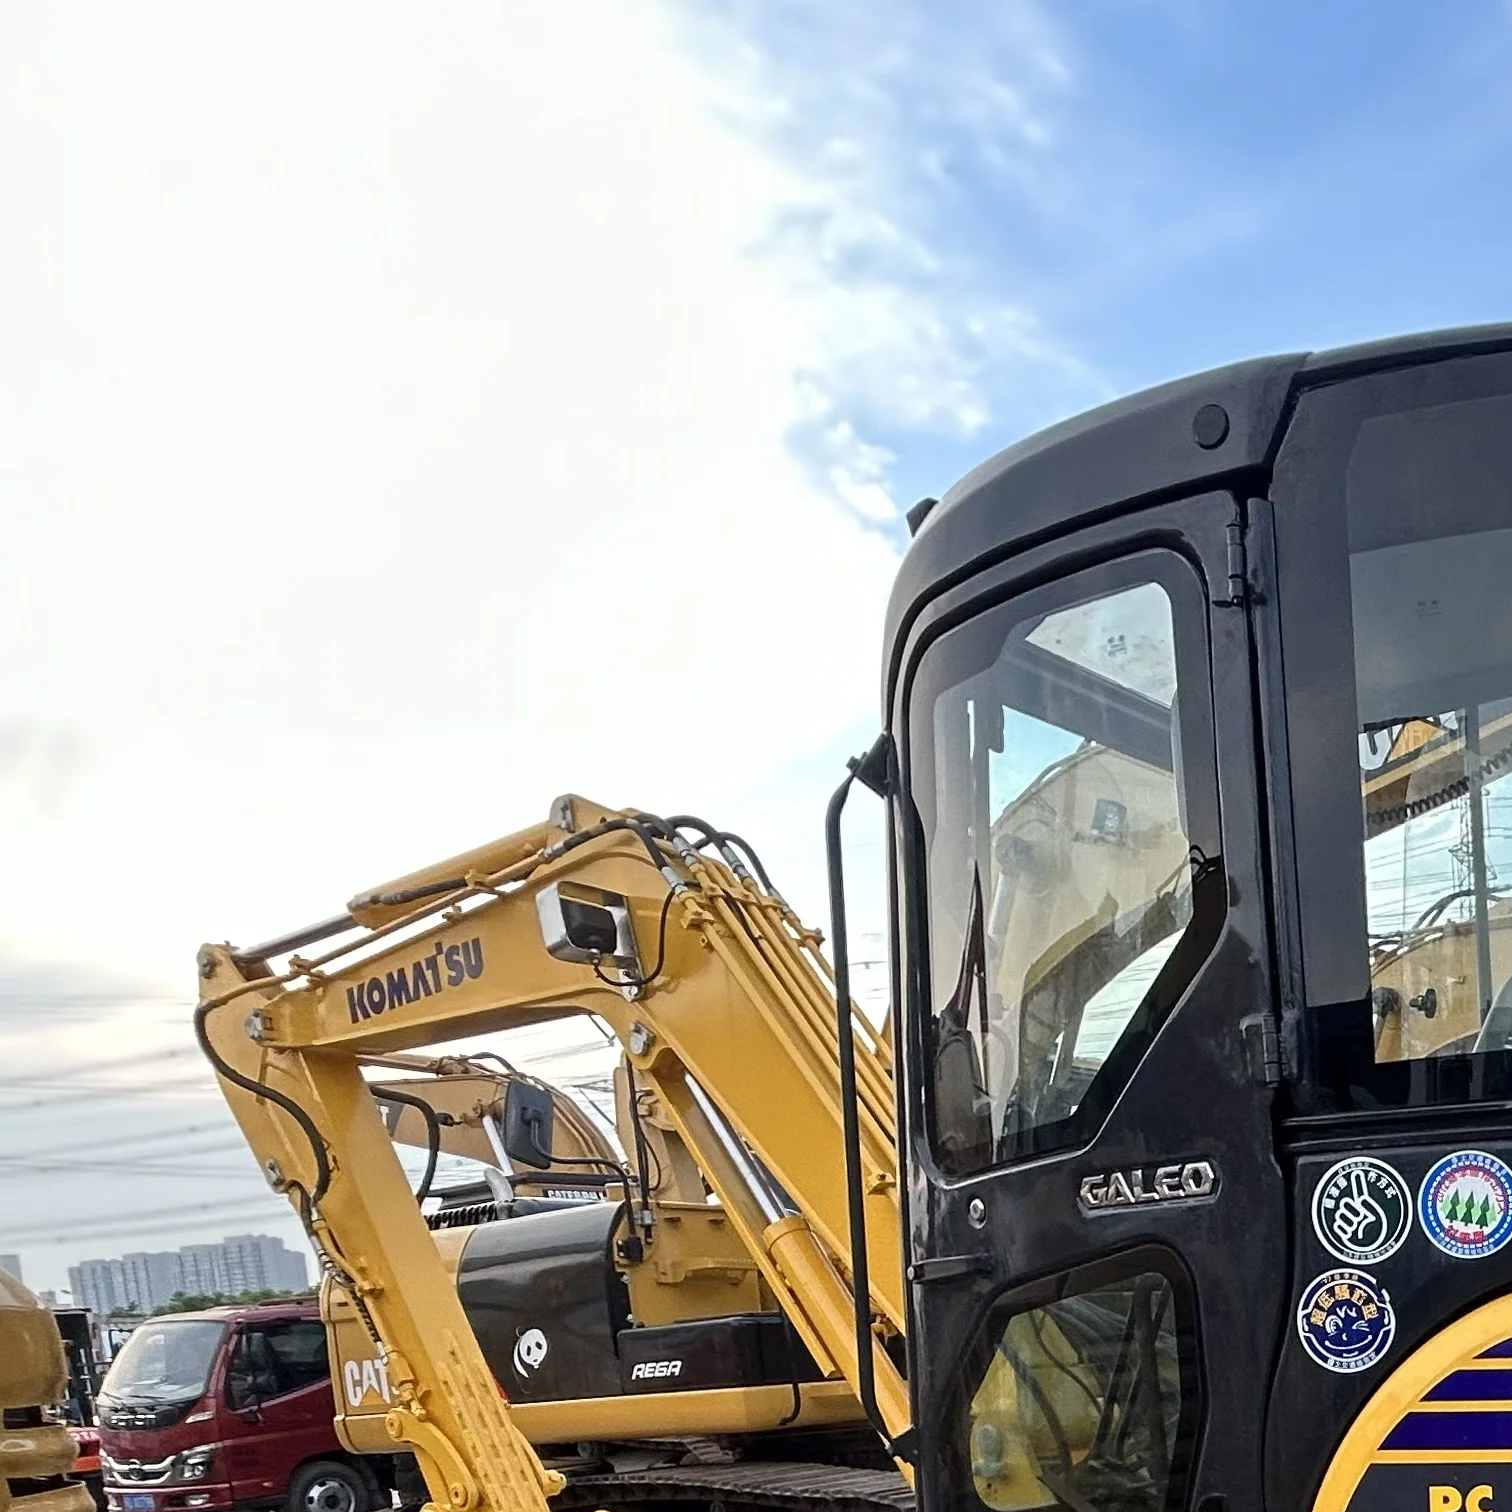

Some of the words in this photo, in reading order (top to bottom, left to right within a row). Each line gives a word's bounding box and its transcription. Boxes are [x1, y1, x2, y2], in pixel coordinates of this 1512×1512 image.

[346, 937, 484, 1024] KOMATSU
[1080, 1161, 1214, 1206] GALEO
[344, 1359, 391, 1407] CAT
